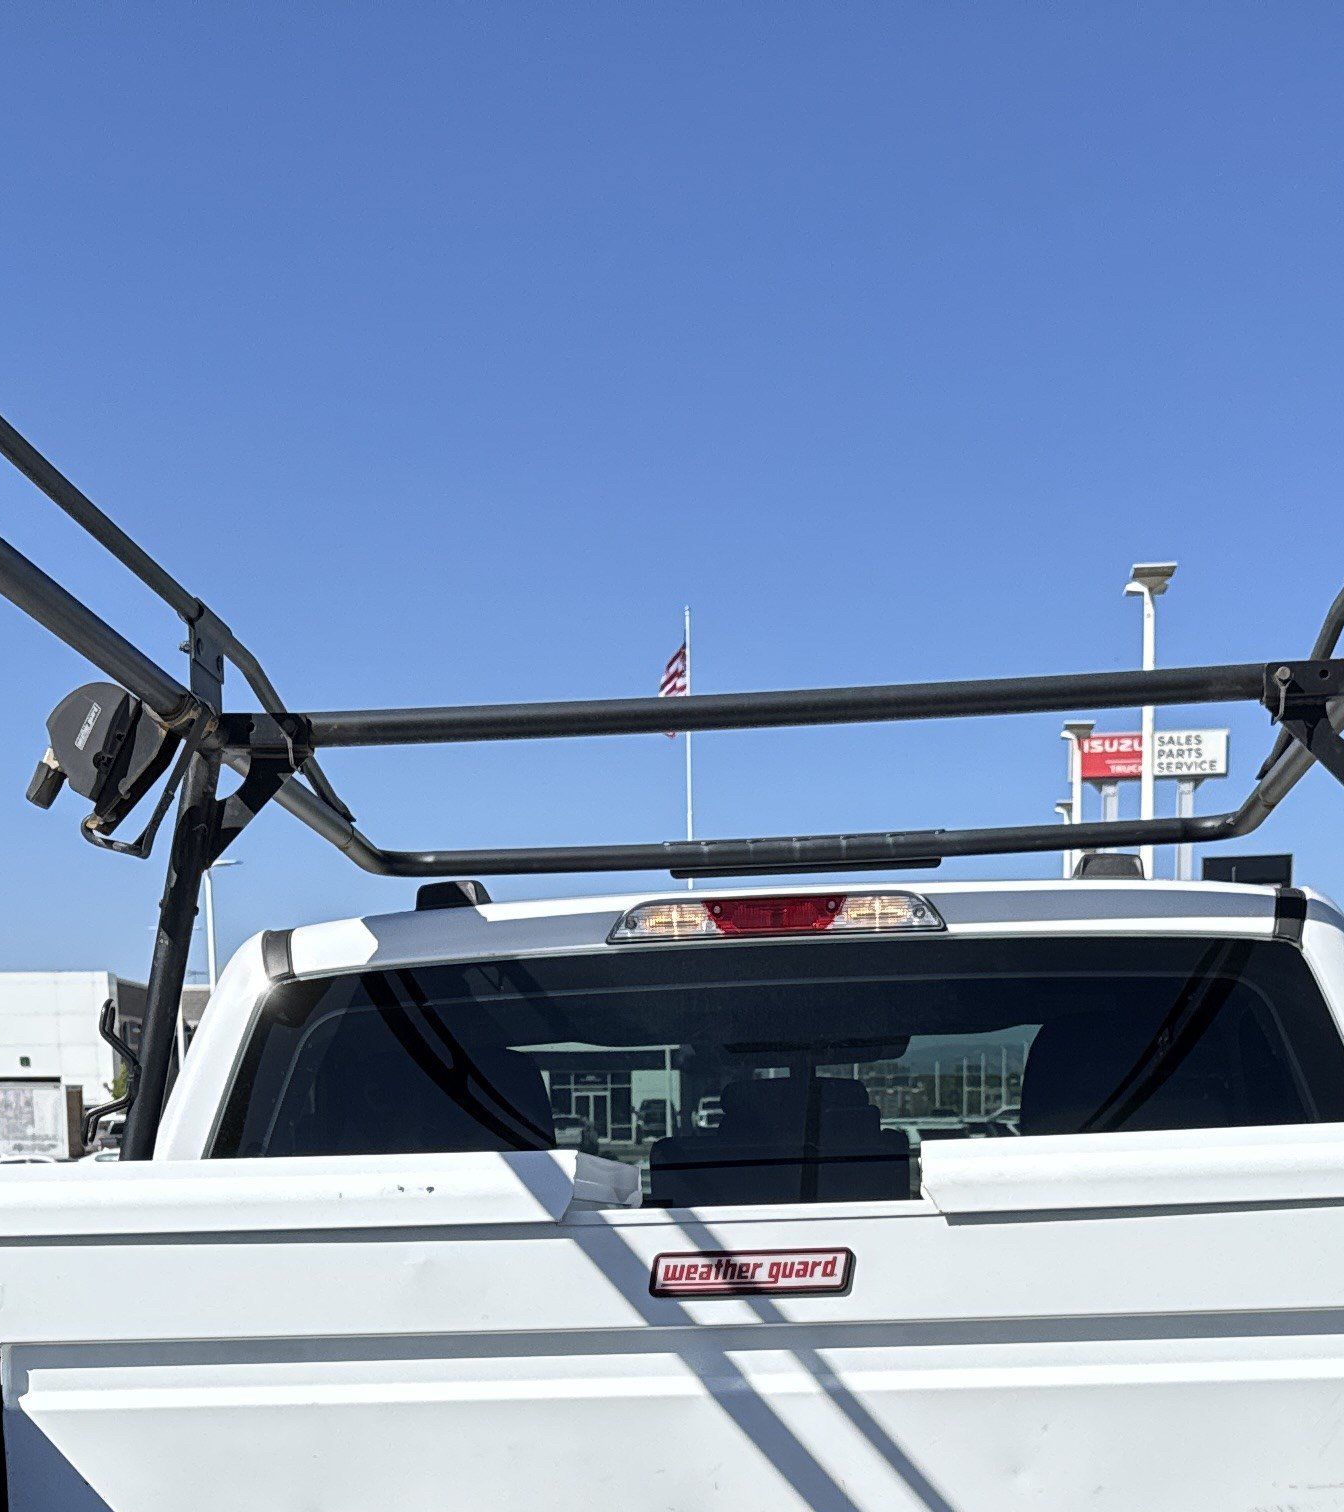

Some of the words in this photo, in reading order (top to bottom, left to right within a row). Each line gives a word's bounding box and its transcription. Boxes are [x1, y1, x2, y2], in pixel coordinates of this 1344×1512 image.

[1157, 735, 1202, 747] SALES
[1157, 748, 1202, 760] PARTS
[1157, 760, 1217, 773] SERVICE
[662, 1258, 763, 1282] weather
[767, 1256, 838, 1285] guard
